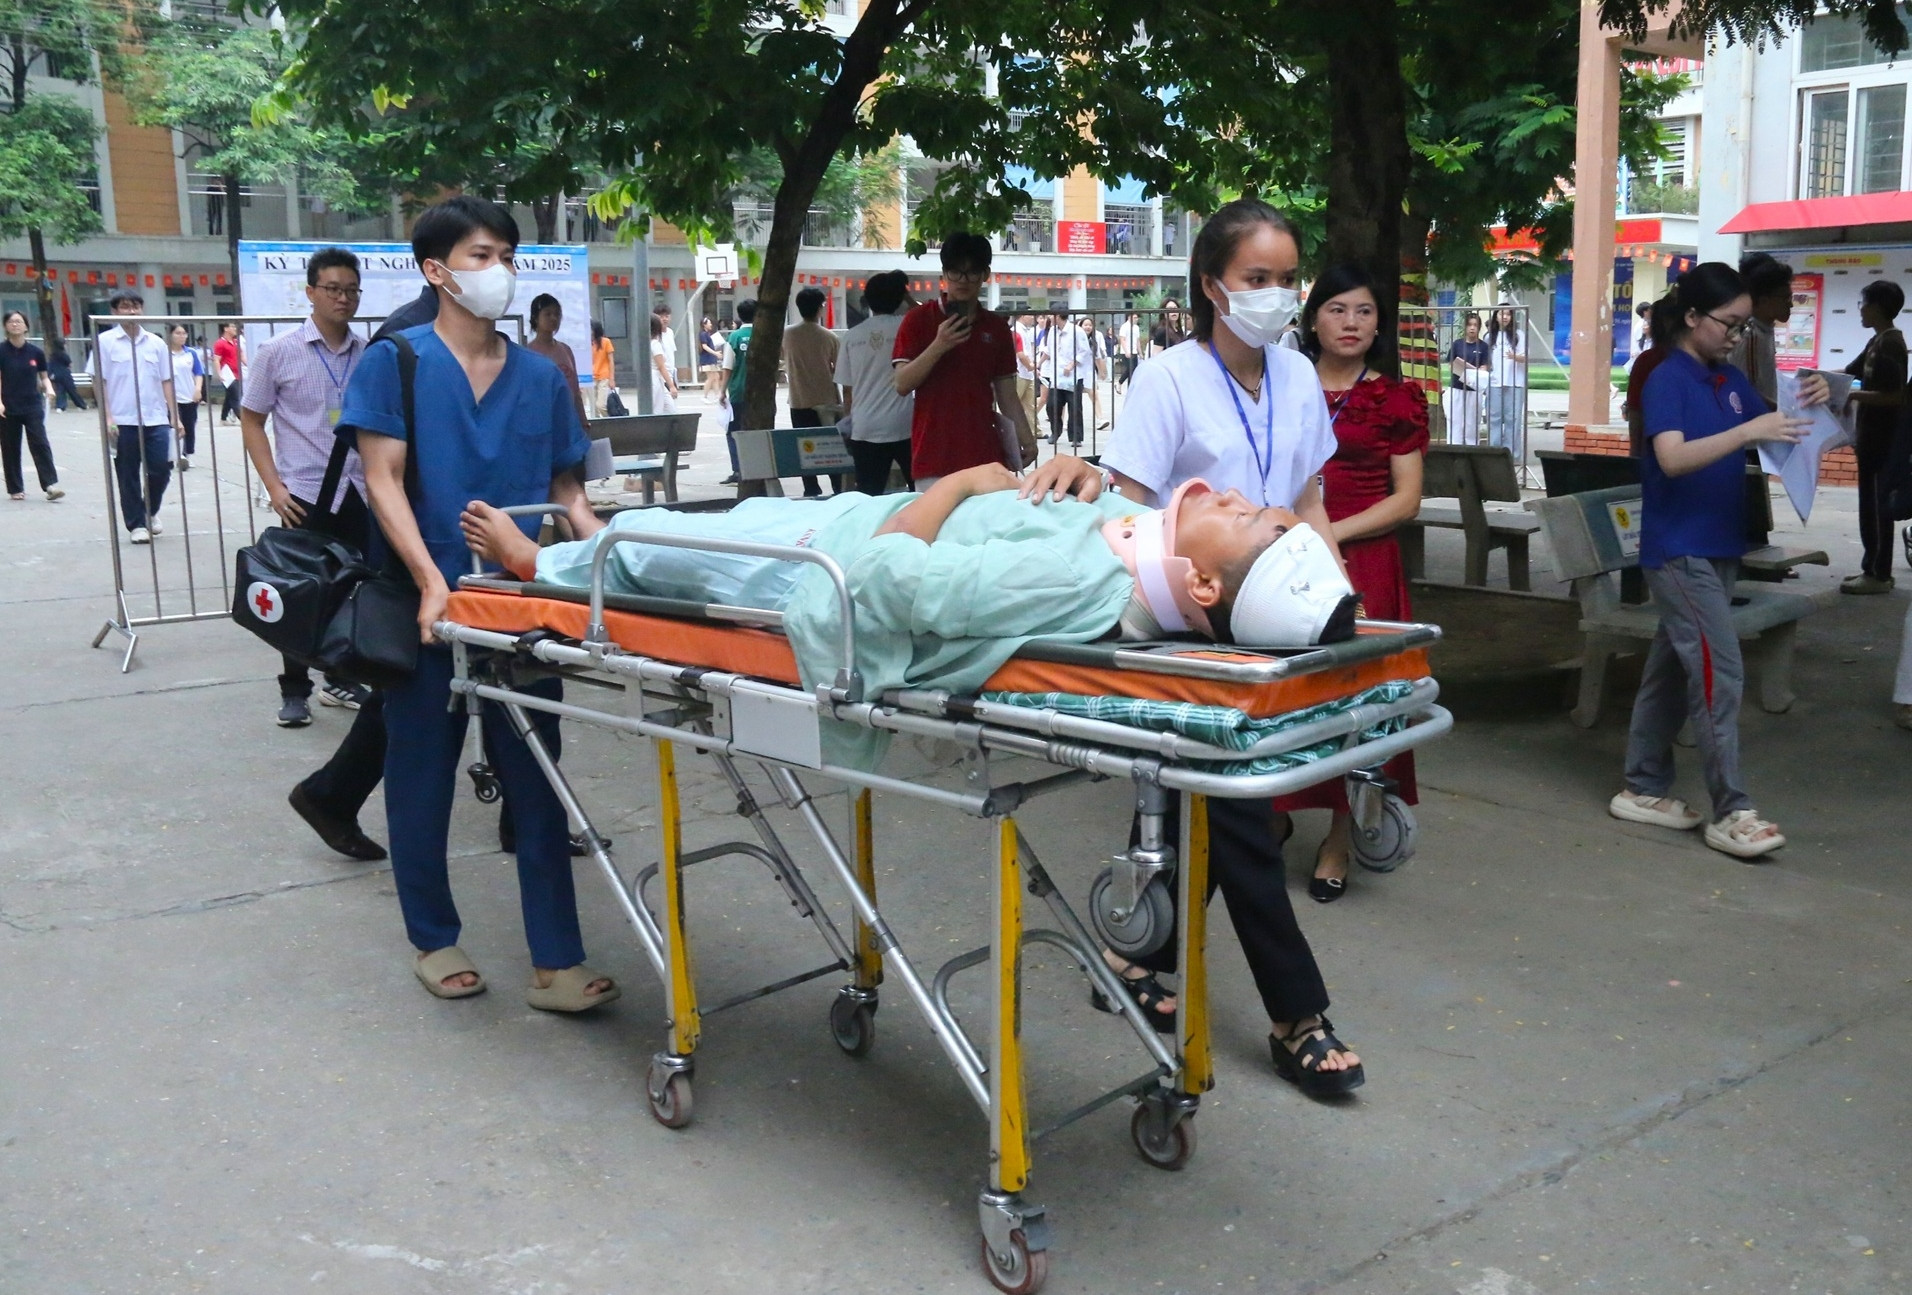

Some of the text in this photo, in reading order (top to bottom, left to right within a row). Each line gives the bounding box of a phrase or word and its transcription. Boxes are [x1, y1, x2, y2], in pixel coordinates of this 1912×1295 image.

[265, 253, 288, 270] KỲ
[380, 256, 416, 270] NGH
[541, 258, 571, 271] 2025
